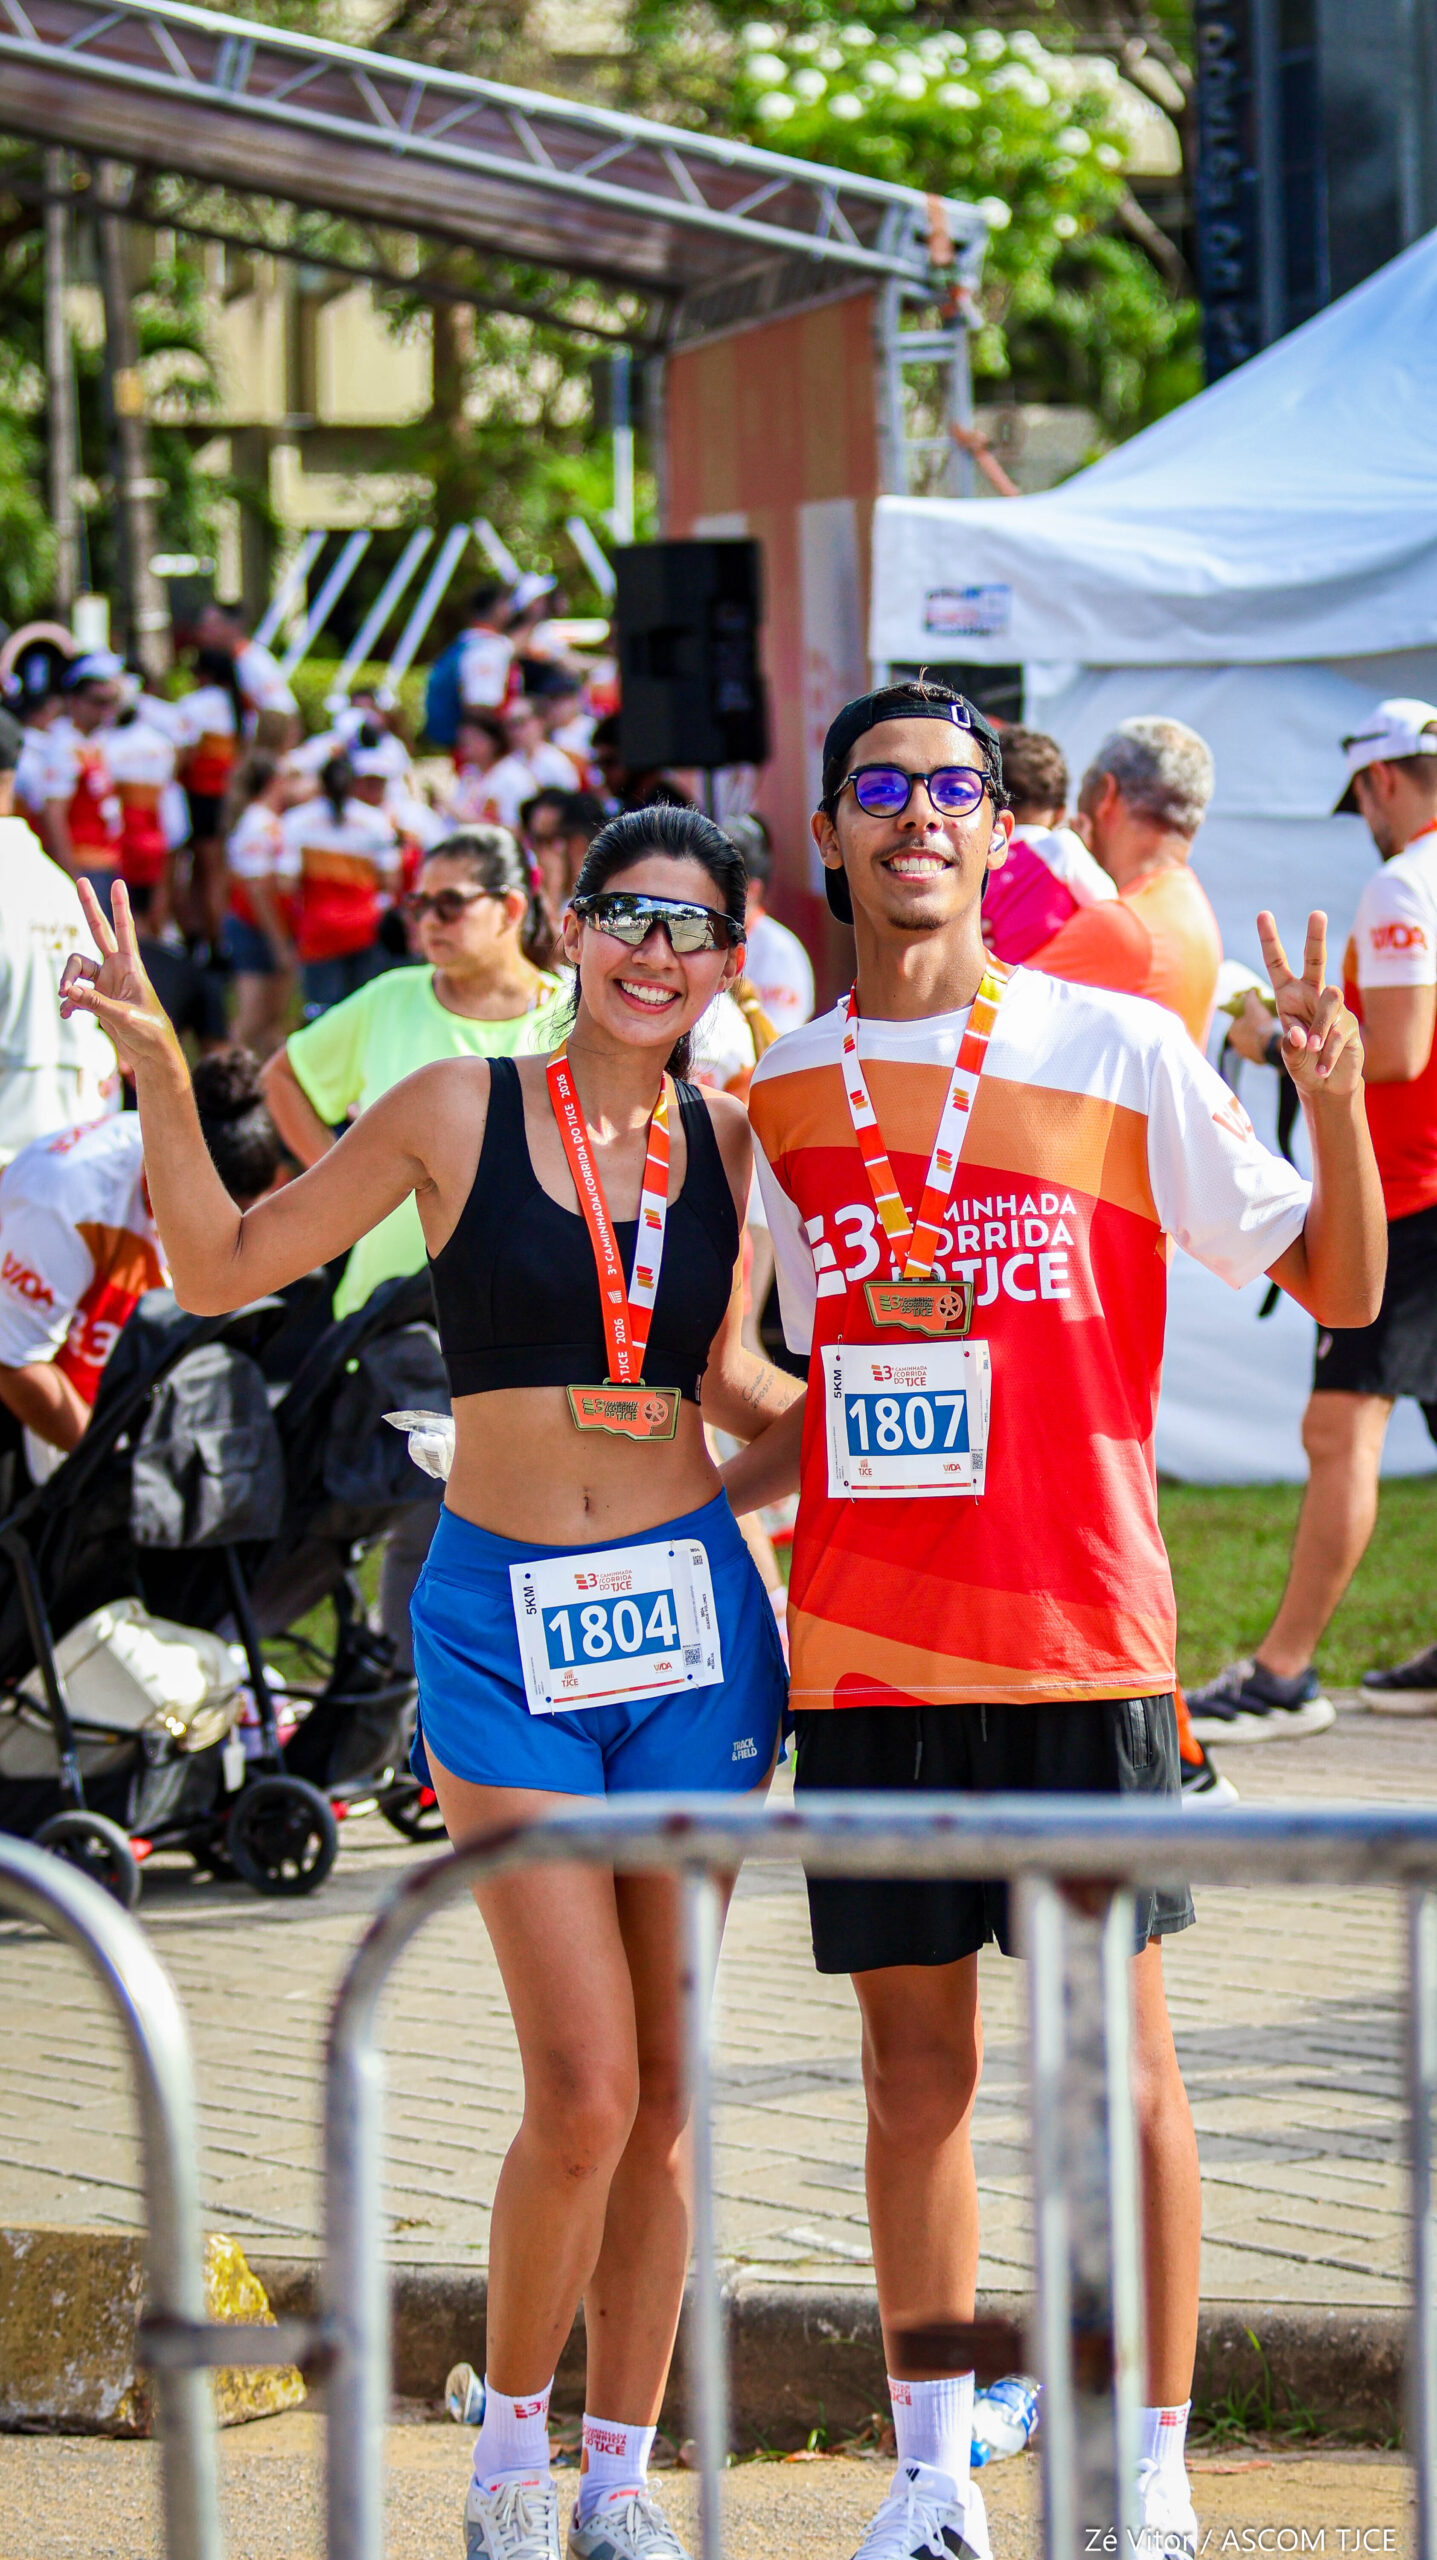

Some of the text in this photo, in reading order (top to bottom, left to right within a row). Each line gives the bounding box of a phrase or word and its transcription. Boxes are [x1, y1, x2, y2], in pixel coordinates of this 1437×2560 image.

[556, 1074, 570, 1099] 2026
[564, 1103, 578, 1126] TJCE
[572, 1127, 584, 1144] DO
[952, 1252, 1071, 1307] TJCE
[614, 1318, 626, 1344] 2026
[618, 1351, 630, 1376] TJCE
[833, 1369, 842, 1399] 5KM
[905, 1377, 927, 1387] TJCE
[848, 1394, 965, 1451] 1807
[858, 1468, 873, 1476] TJCE
[611, 1581, 632, 1592] TJCE
[524, 1585, 538, 1615] 5KM
[548, 1594, 678, 1662] 1804
[562, 1678, 579, 1688] TJCE
[732, 1747, 758, 1761] & FIELD
[733, 1737, 755, 1751] TRACK
[595, 2440, 625, 2457] TJCE
